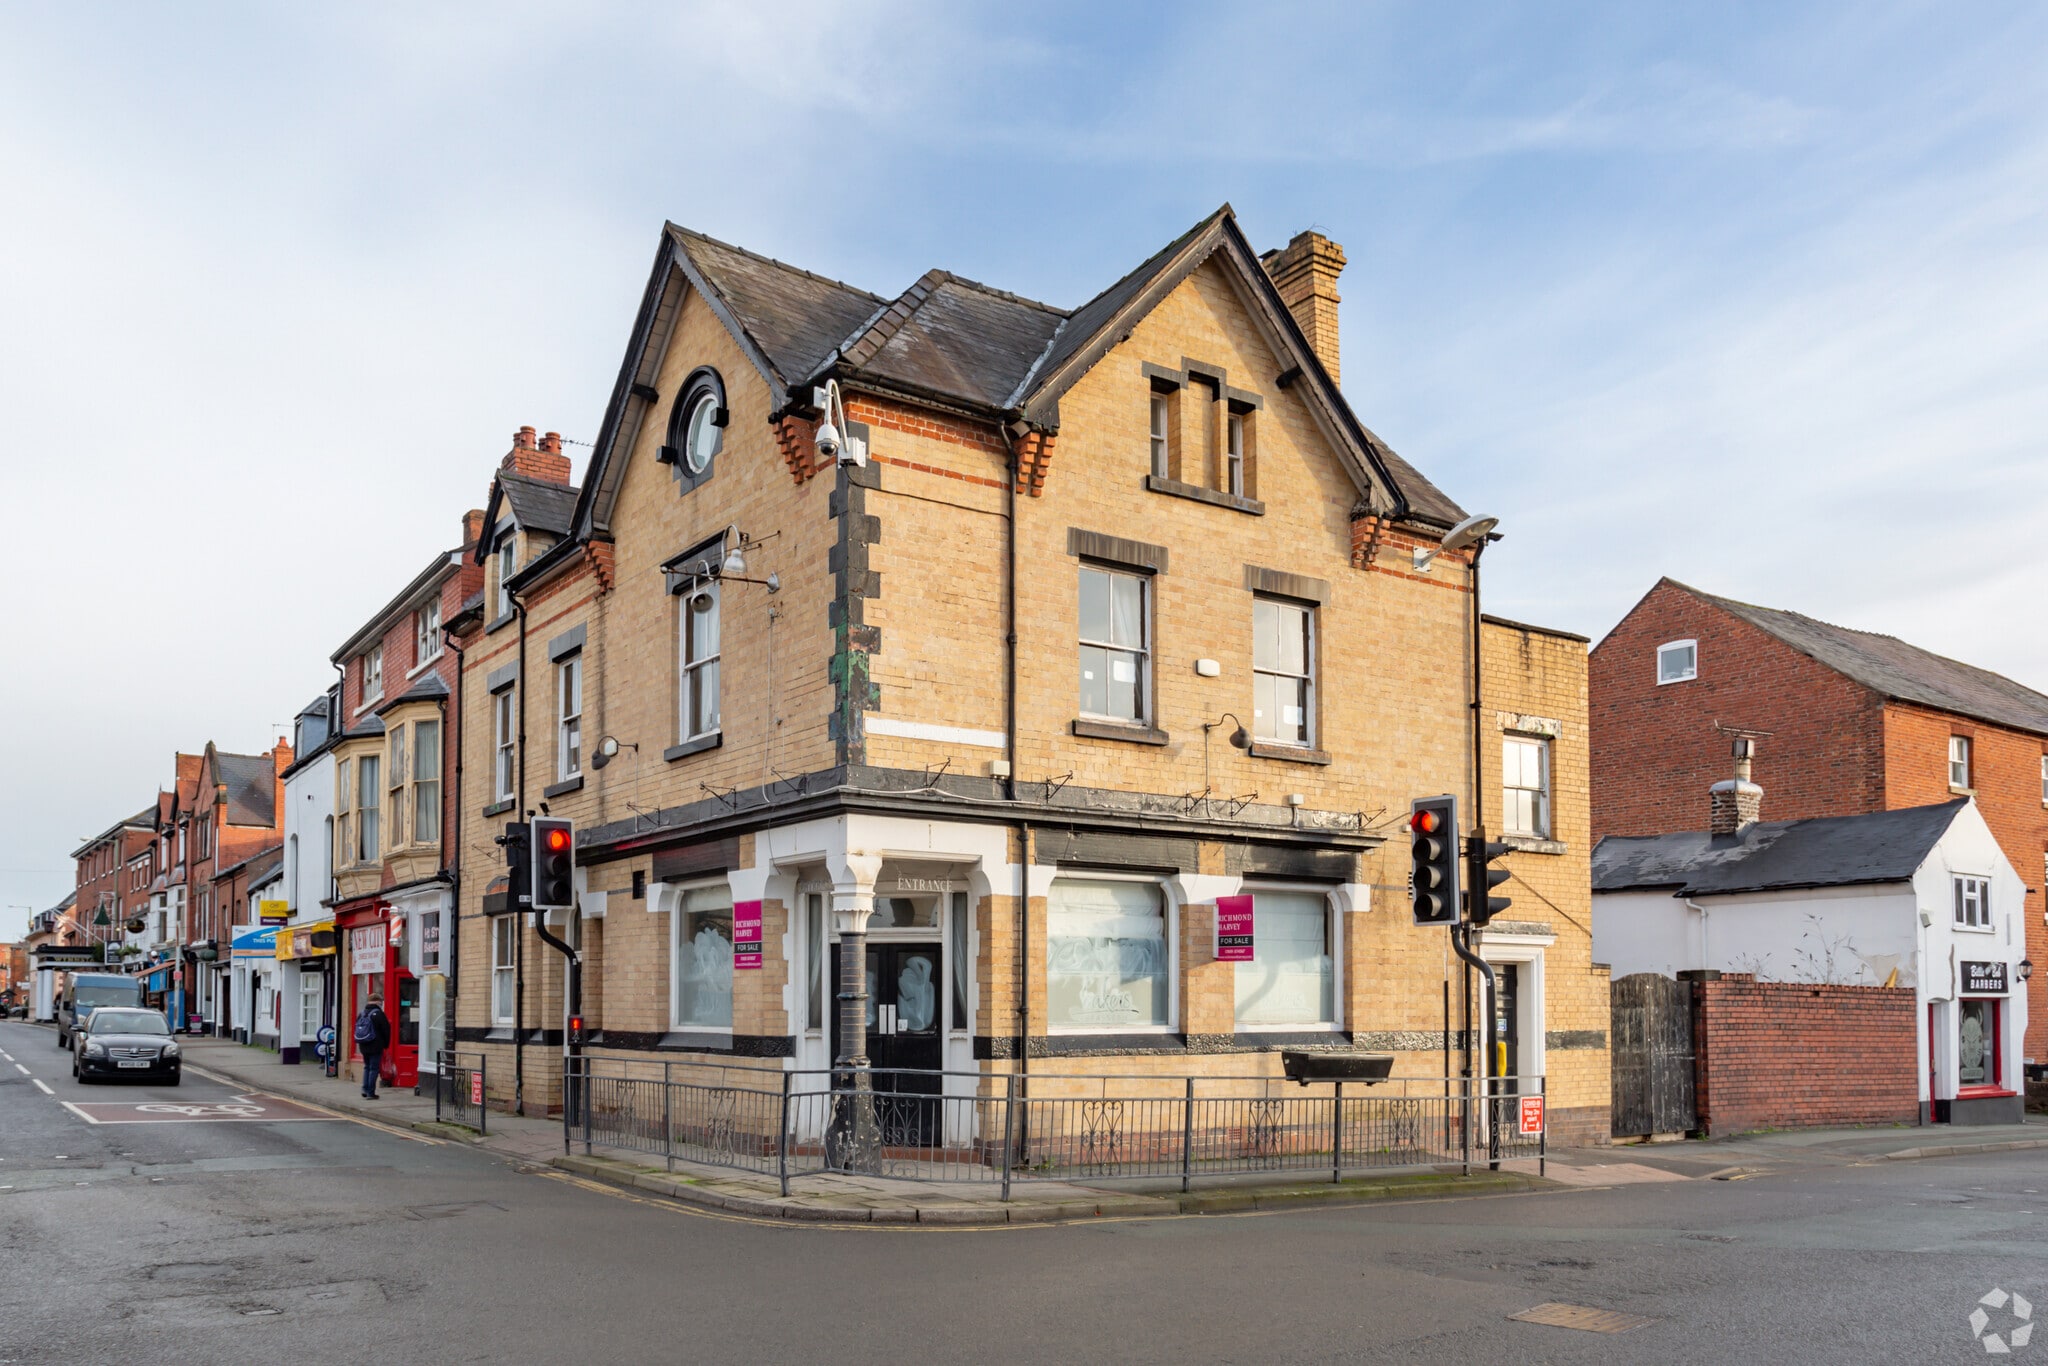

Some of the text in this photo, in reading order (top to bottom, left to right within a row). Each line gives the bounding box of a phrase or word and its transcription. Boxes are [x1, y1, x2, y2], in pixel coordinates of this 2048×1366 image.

[898, 878, 953, 892] ENTRANCE
[736, 920, 760, 928] RICHMOND
[747, 943, 759, 951] SALE
[1970, 979, 2002, 989] BARBERS
